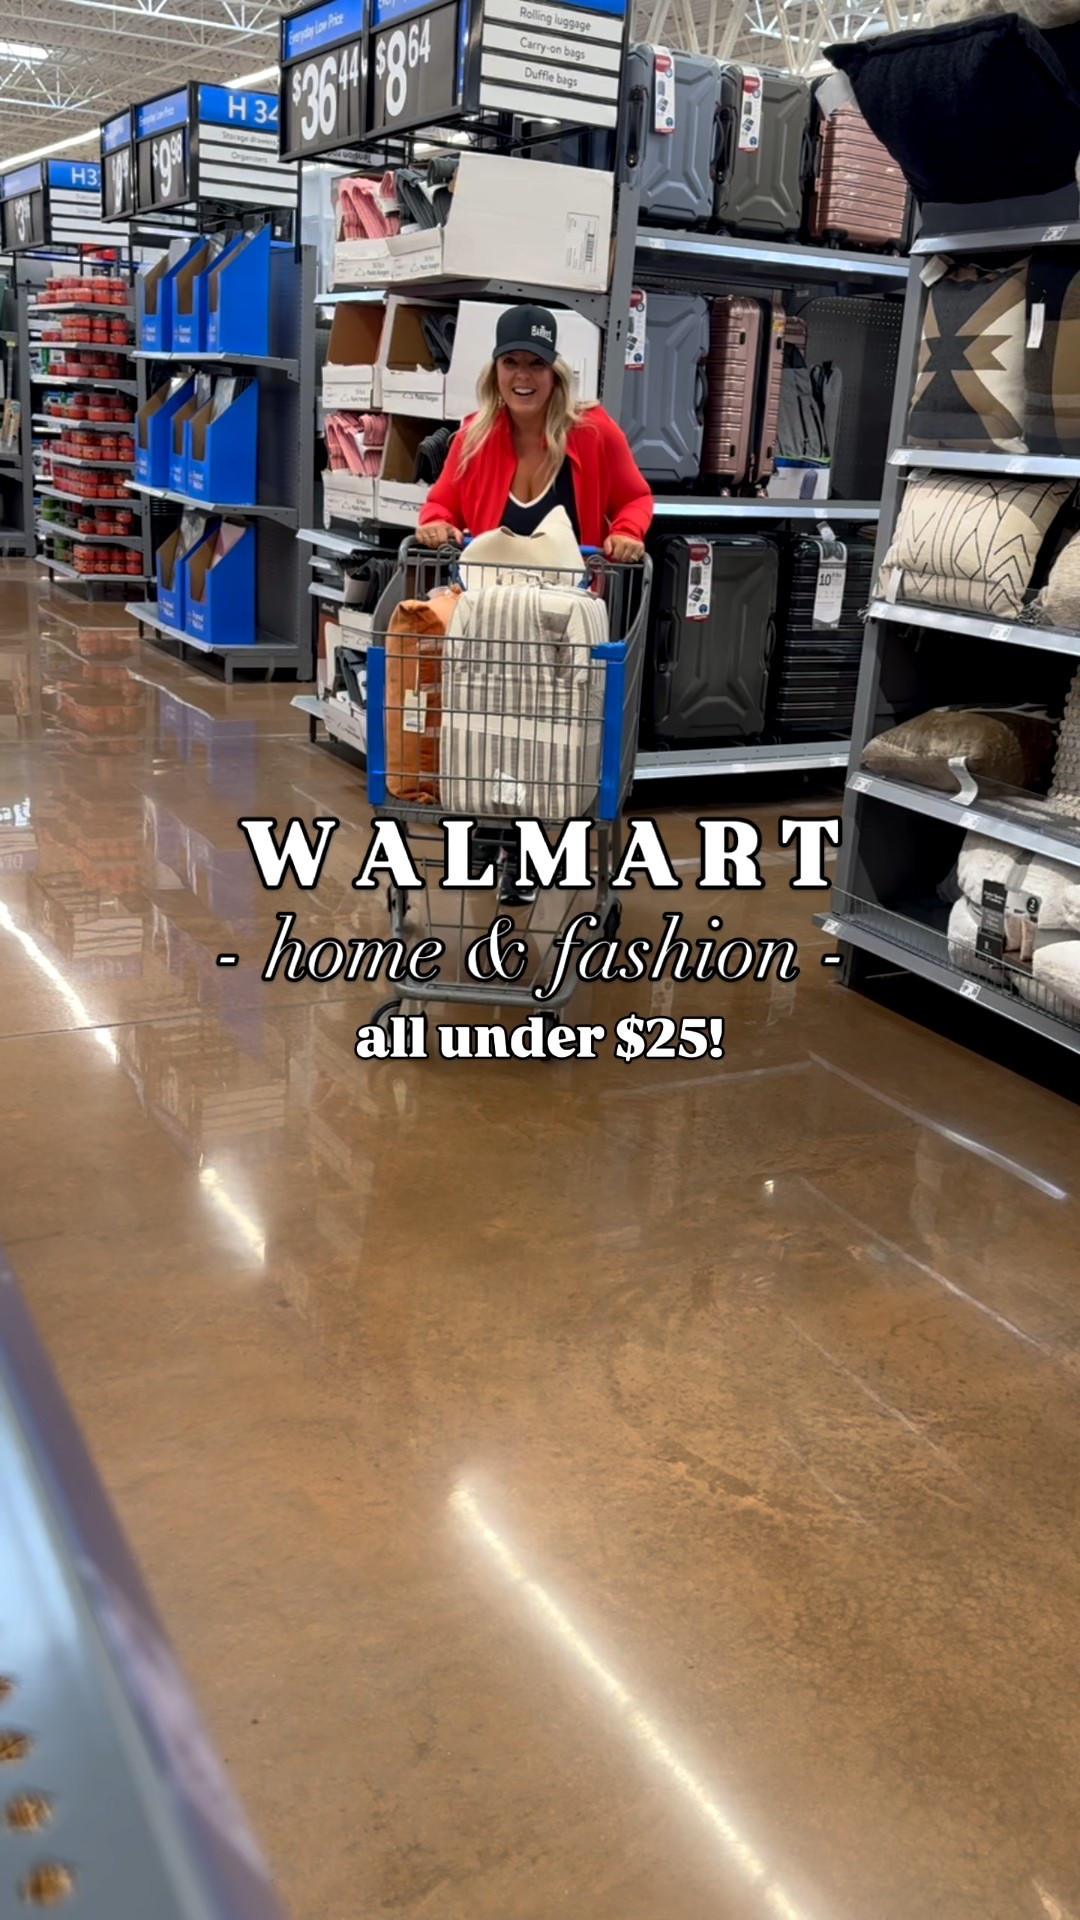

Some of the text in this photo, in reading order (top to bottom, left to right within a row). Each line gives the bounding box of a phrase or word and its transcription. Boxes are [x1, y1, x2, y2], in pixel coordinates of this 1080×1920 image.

[520, 6, 591, 32] Rolling luggage
[519, 37, 586, 61] Carry-on bags
[524, 66, 578, 89] Duffle bags
[228, 95, 246, 121] H
